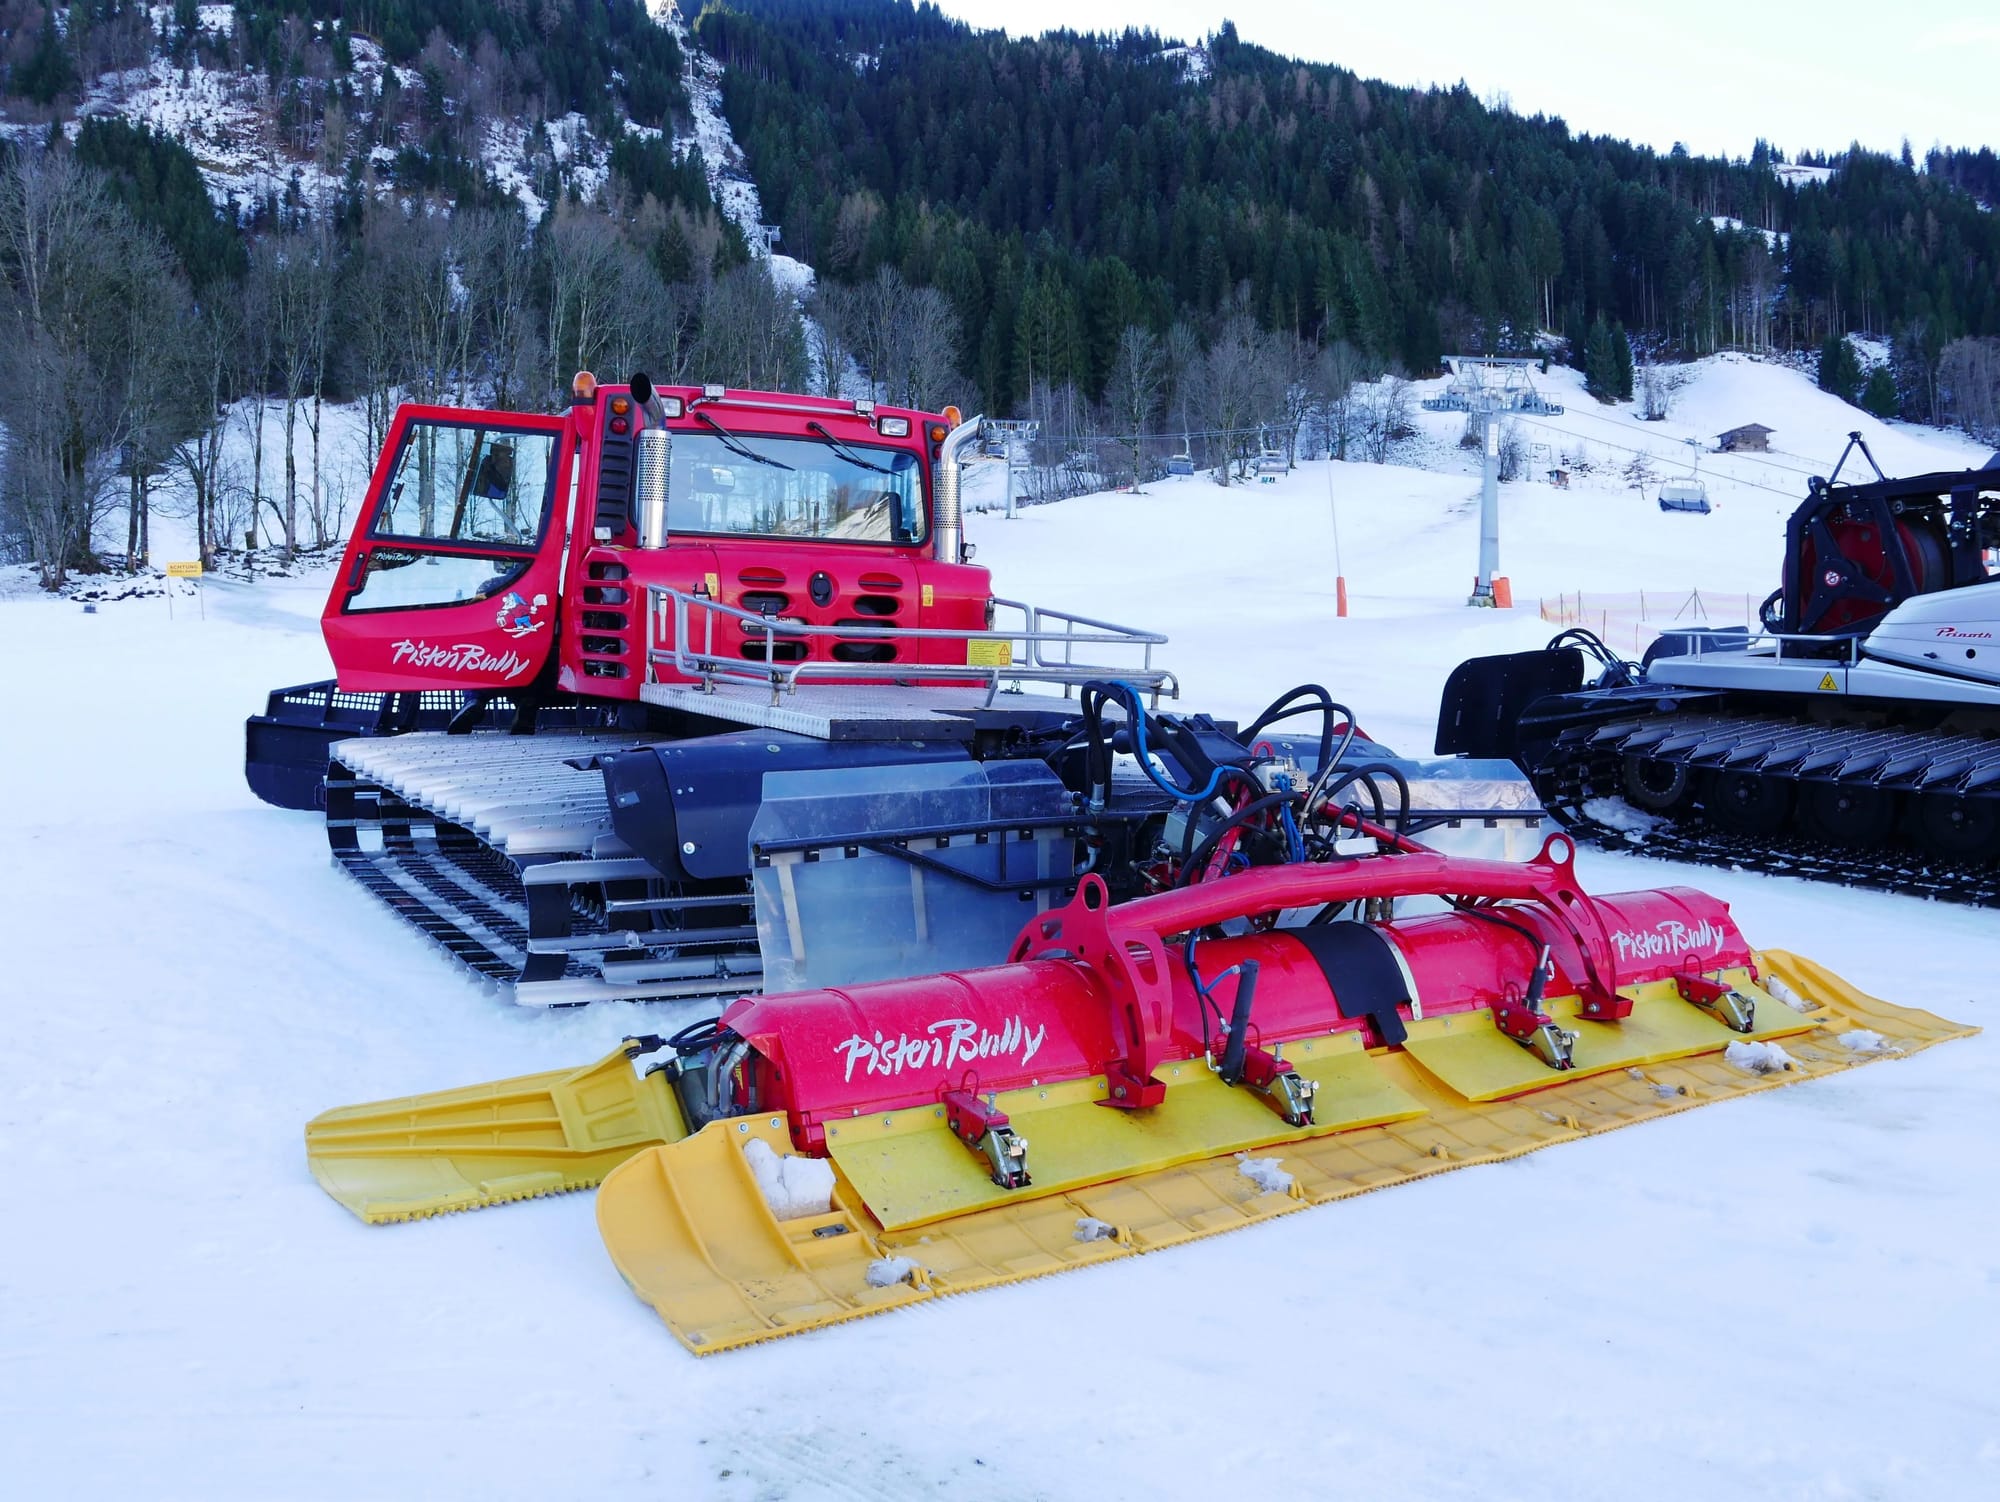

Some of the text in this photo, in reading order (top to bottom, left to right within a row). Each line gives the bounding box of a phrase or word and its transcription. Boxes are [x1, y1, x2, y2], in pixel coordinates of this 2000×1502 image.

[391, 639, 530, 680] PistenBully
[1610, 918, 1724, 962] PistenBully
[833, 1014, 1045, 1083] PistenBully
